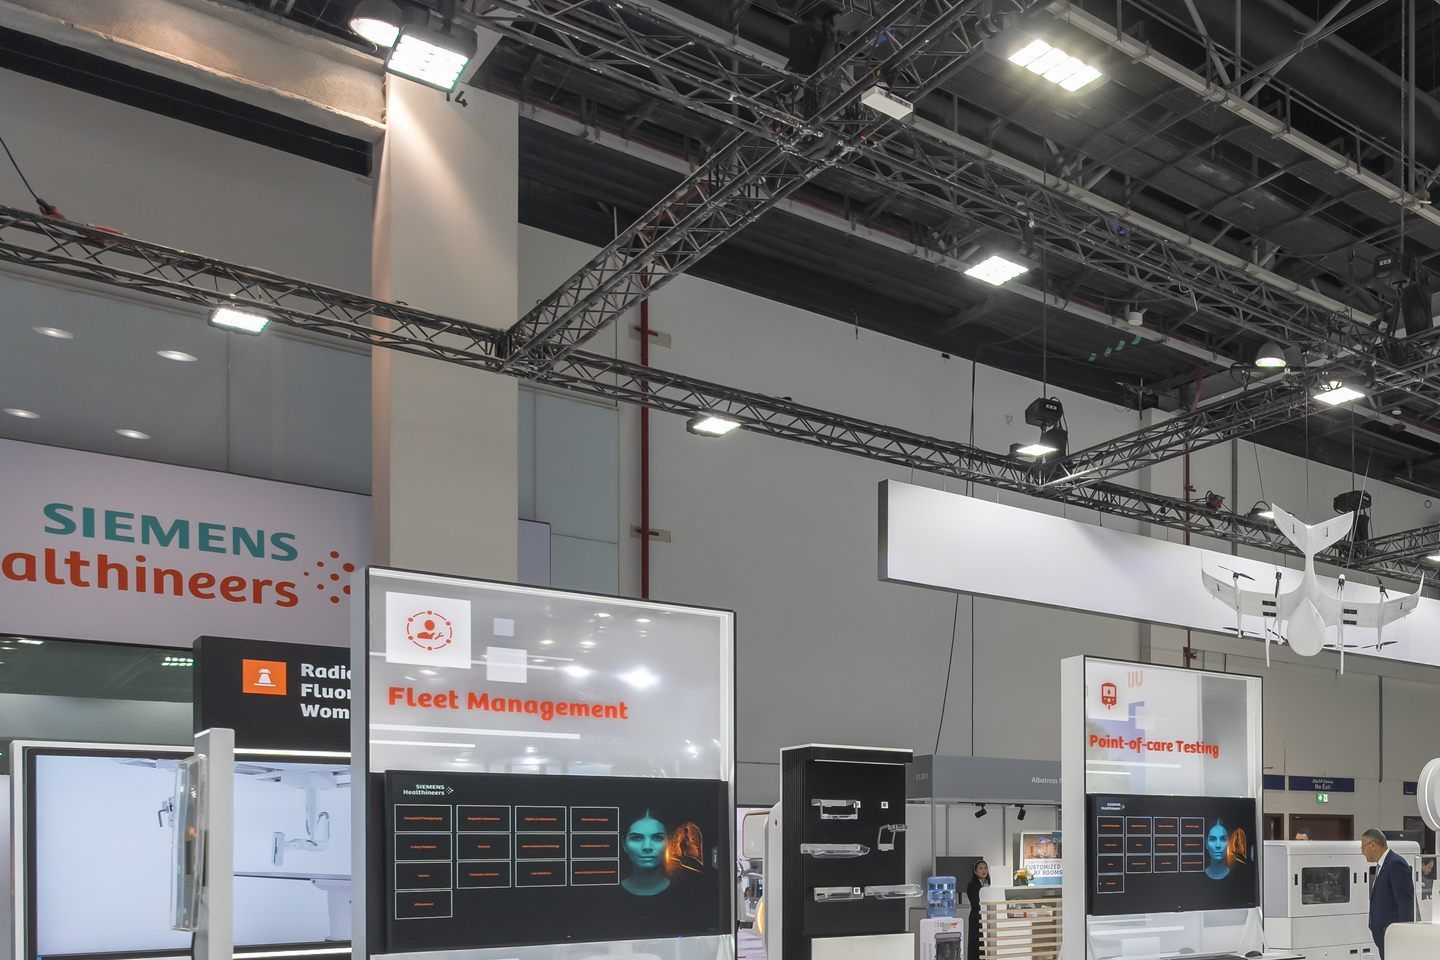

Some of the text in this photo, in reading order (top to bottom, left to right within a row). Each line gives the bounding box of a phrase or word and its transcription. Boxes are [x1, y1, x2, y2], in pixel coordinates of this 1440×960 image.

[43, 502, 299, 562] SIEMENS
[1, 548, 299, 608] althineers
[300, 703, 350, 720] Wom
[388, 686, 629, 721] Fleet Management
[1089, 734, 1219, 759] Point-of-care Testing
[1031, 776, 1059, 784] Albatross
